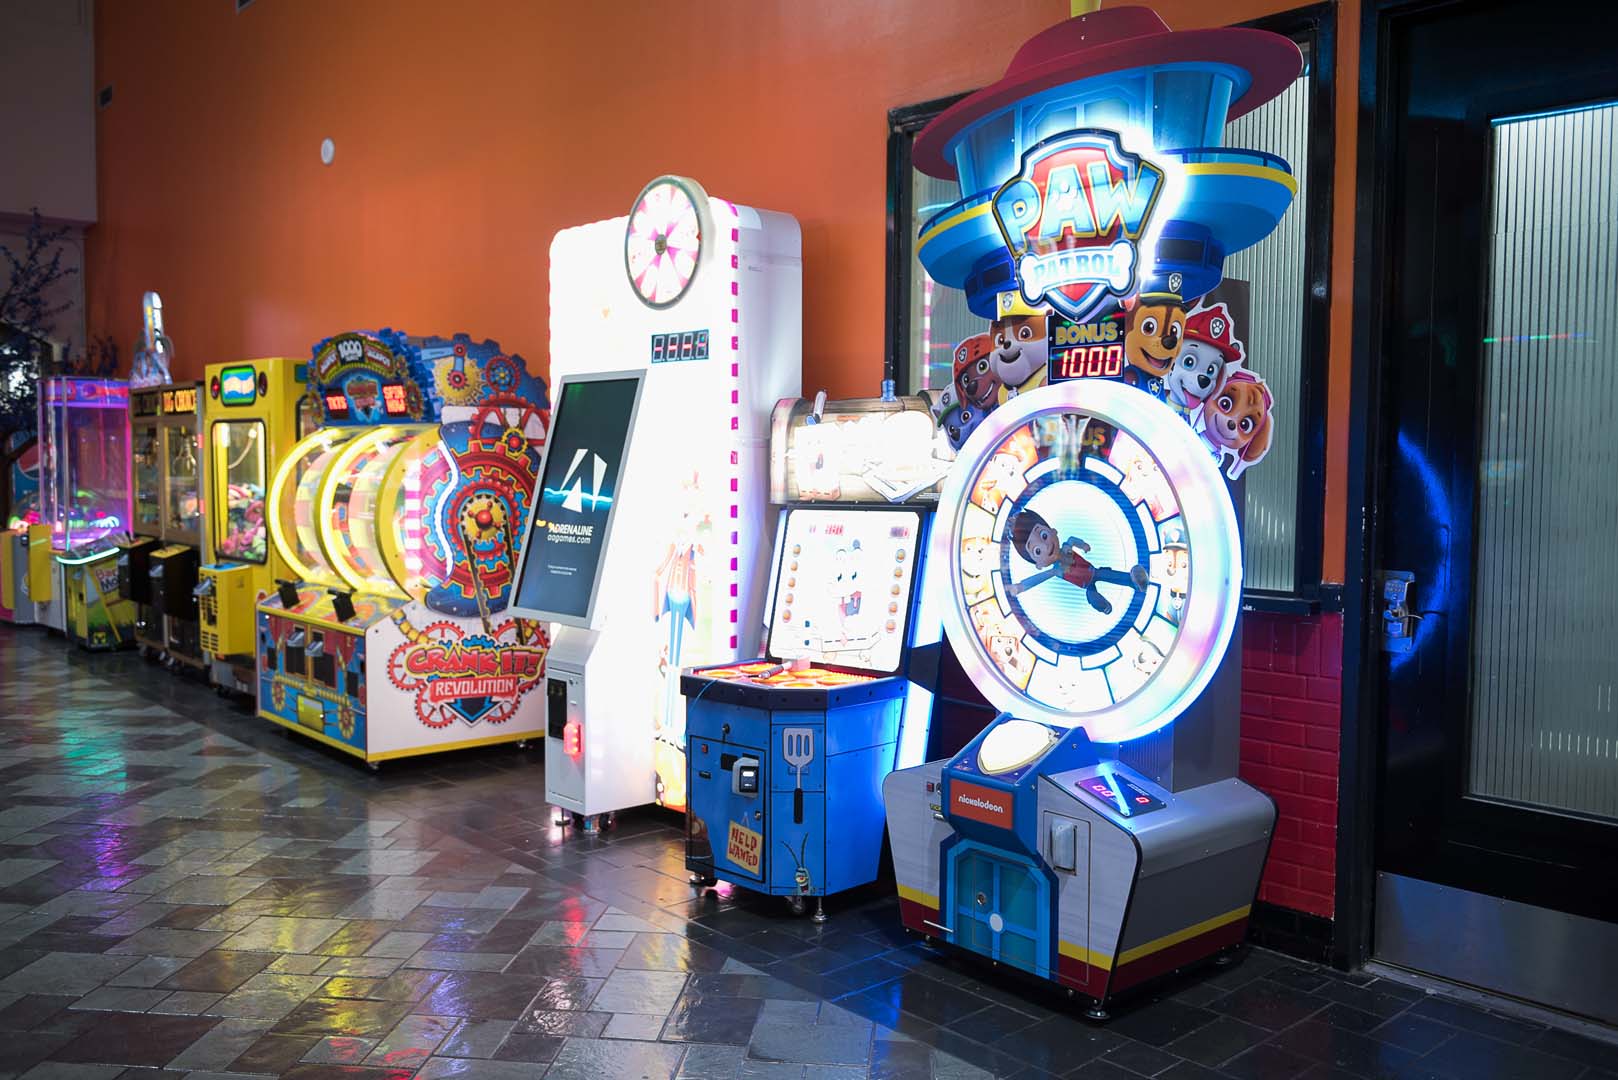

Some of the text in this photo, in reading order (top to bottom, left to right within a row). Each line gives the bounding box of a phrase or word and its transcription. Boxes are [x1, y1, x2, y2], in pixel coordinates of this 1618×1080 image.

[992, 161, 1164, 257] PAW
[1033, 253, 1121, 280] PATROL
[1055, 322, 1118, 345] BONUS
[1062, 345, 1122, 377] 1000
[548, 522, 593, 537] ADRENALINE
[407, 648, 543, 675] CRANK IT!
[435, 679, 515, 697] REVOLUTION
[958, 793, 1004, 814] nickelodeon
[731, 827, 758, 851] HELP
[729, 842, 758, 866] WANTED
